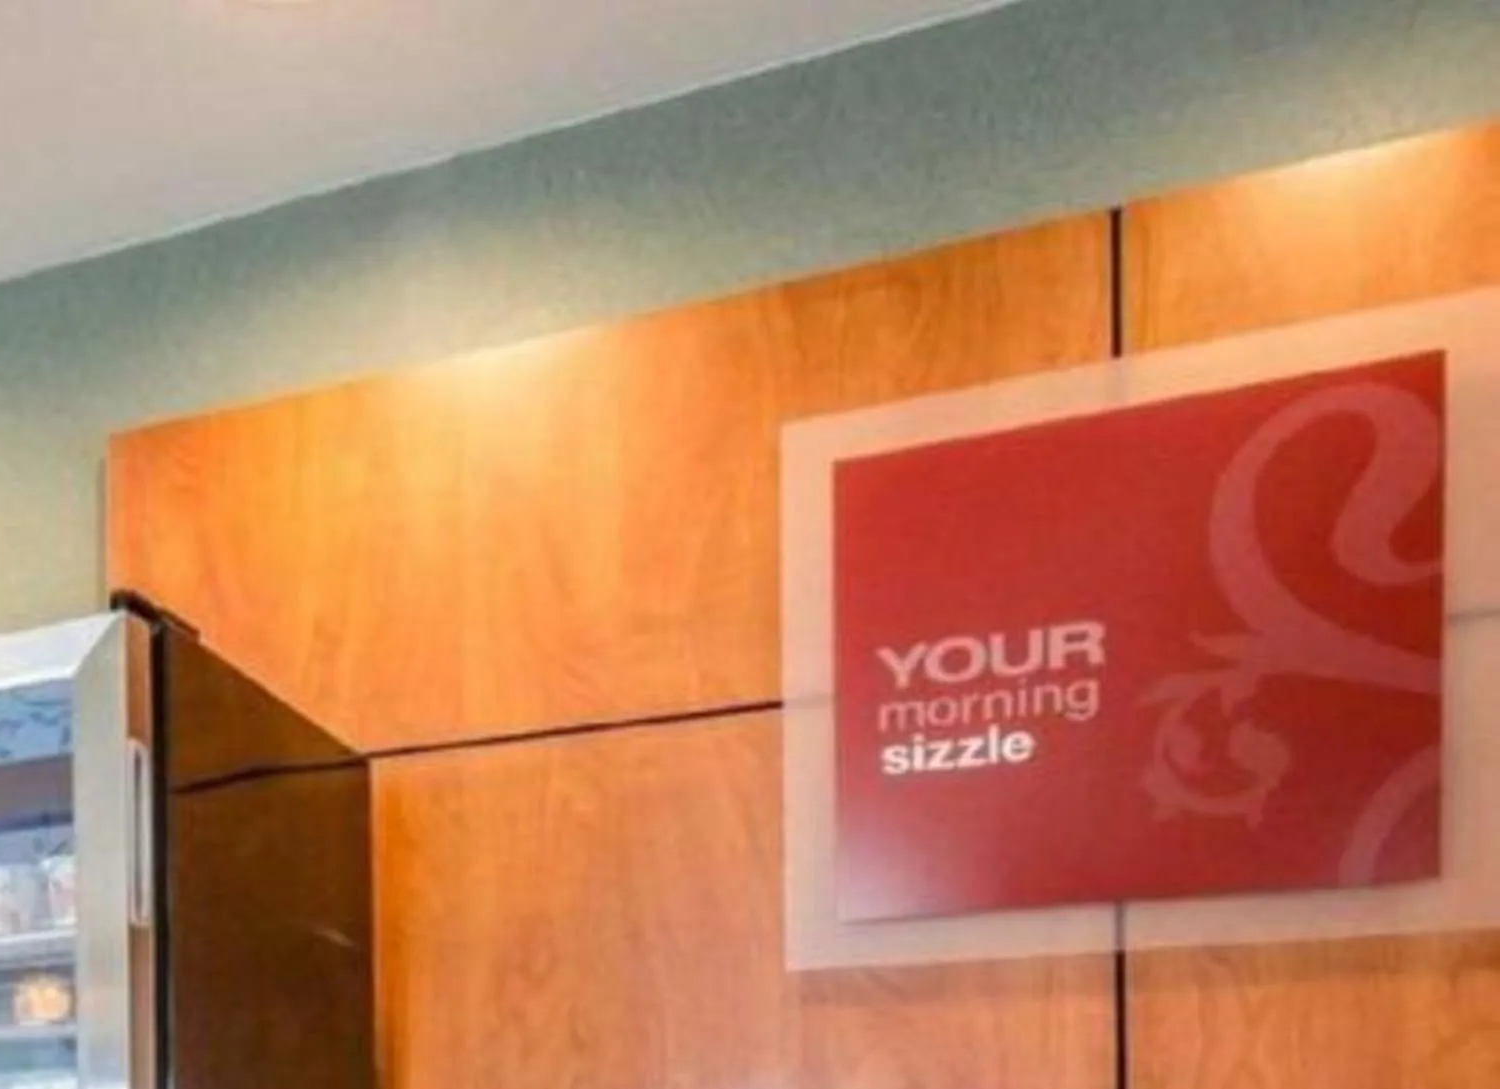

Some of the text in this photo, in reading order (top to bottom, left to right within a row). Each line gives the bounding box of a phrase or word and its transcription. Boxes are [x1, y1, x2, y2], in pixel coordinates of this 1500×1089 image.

[876, 620, 1105, 688] YOUR
[877, 678, 1099, 732] morning
[881, 724, 1035, 774] sizzle
